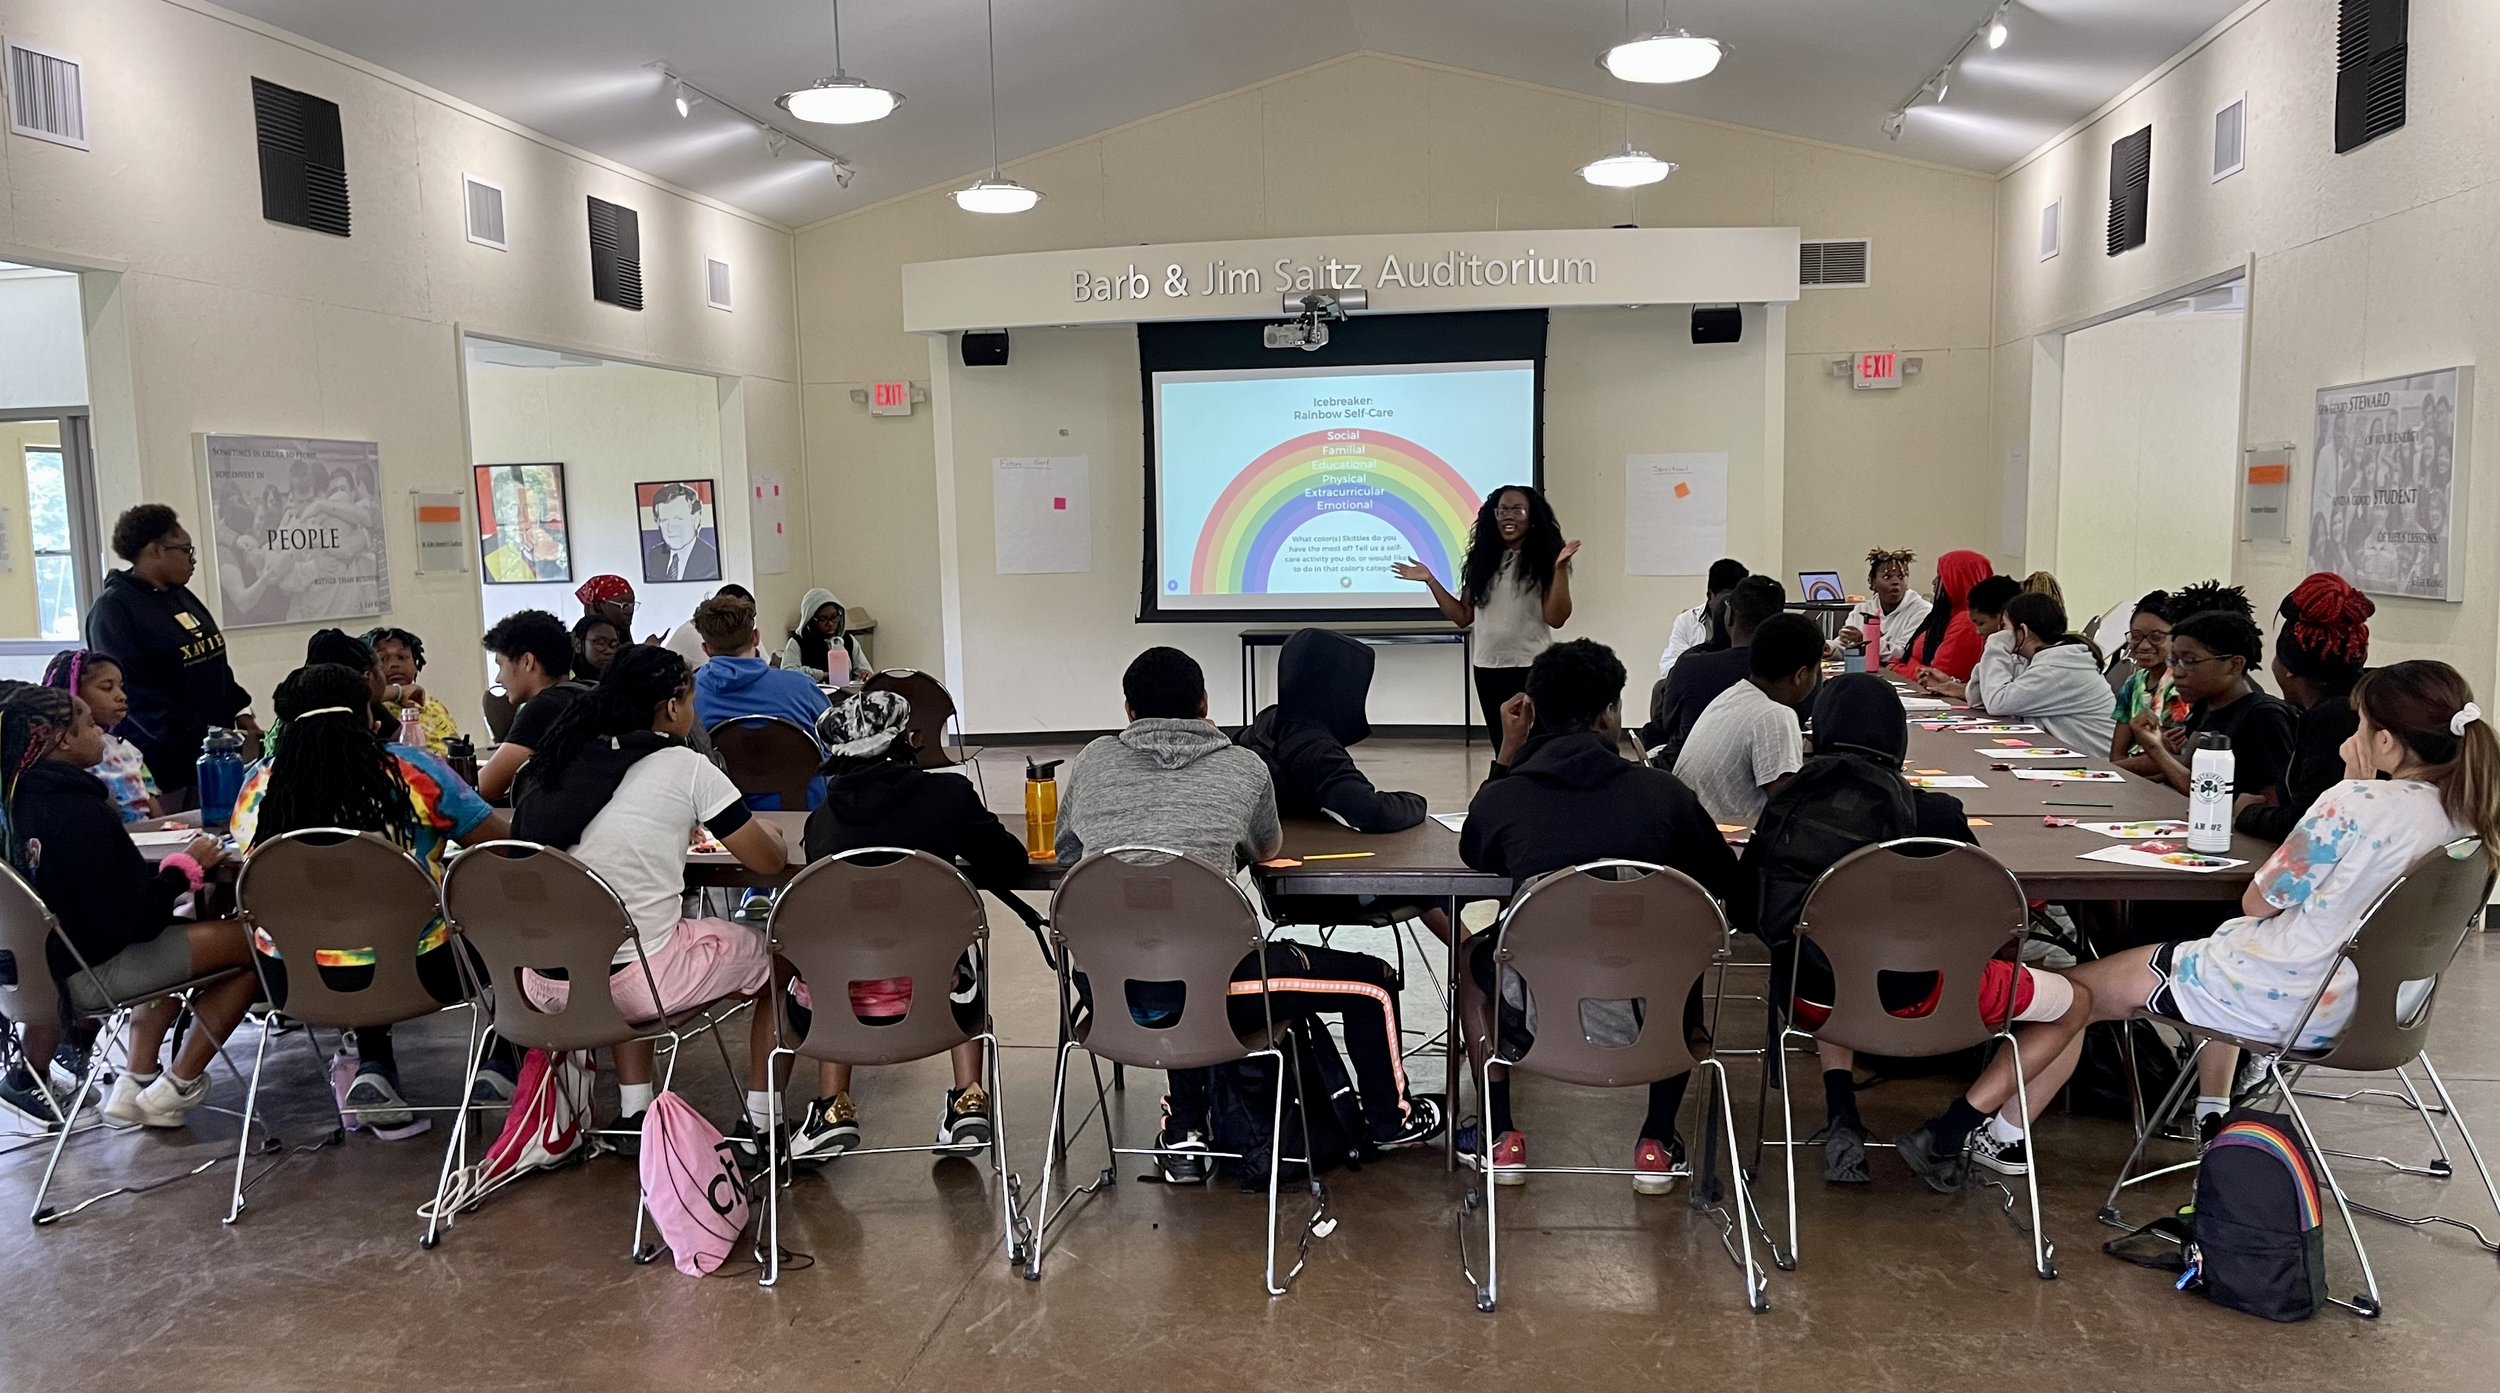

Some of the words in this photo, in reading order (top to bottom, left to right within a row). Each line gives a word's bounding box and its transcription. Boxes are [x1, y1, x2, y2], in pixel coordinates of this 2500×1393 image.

[1072, 264, 1150, 303] Barb
[1163, 263, 1190, 298] &
[1200, 259, 1261, 297] Jim
[1274, 256, 1363, 293] Saitz
[1376, 248, 1598, 290] Auditorium
[1863, 353, 1895, 378] EXIT
[875, 383, 903, 406] EXIT
[1313, 396, 1374, 407] Icebreaker:
[2349, 391, 2391, 412] STEWARD
[1294, 410, 1342, 420] Rainbow
[1344, 408, 1394, 419] Self-Care
[1327, 430, 1360, 441] Social
[1322, 445, 1365, 455] Familial
[1311, 459, 1377, 470] Educational
[1322, 474, 1367, 485] Physical
[1304, 488, 1385, 498] Extracurricular
[2374, 489, 2418, 505] STUDENT
[1316, 500, 1373, 511] Emotional
[266, 528, 341, 551] PEOPLE
[1383, 535, 1397, 543] you
[1302, 555, 1328, 563] activity
[1330, 556, 1344, 564] you
